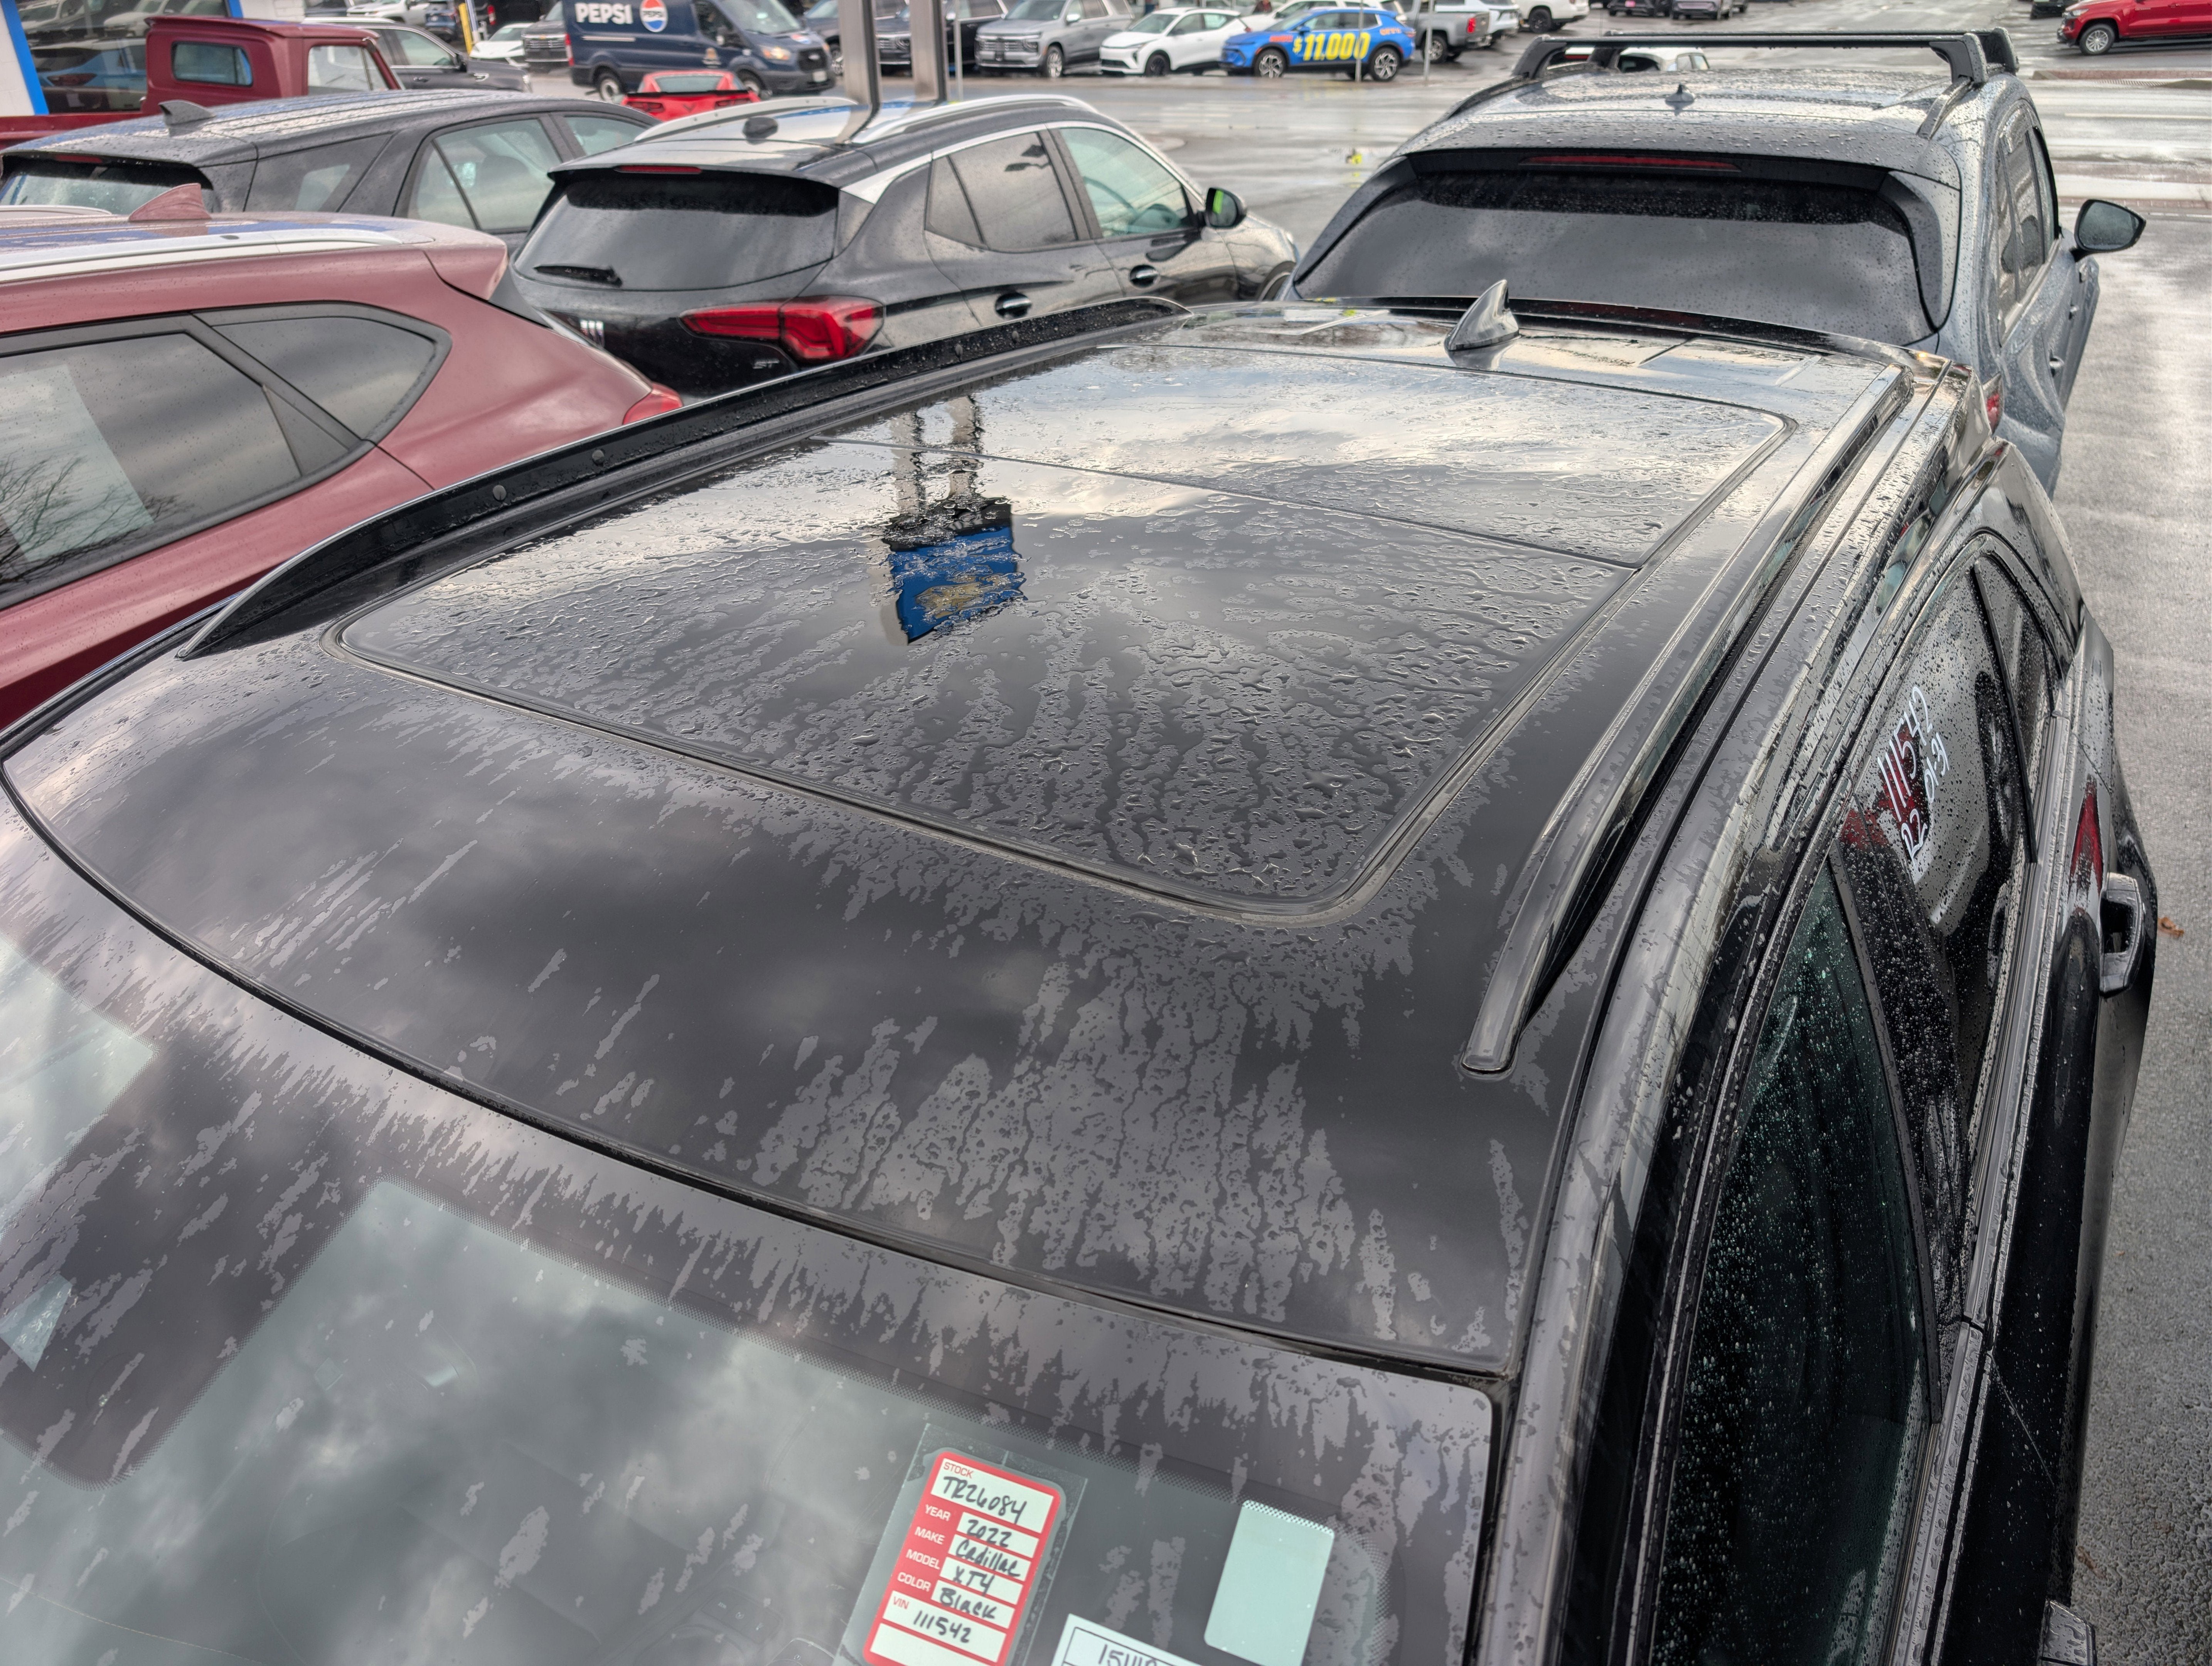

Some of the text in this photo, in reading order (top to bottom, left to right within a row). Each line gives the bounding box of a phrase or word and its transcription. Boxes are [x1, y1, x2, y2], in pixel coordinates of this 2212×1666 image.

[574, 2, 633, 24] PEPSI
[1878, 686, 1932, 822] 111542
[943, 1462, 974, 1479] STOCK
[943, 1476, 1027, 1524] TR26084
[925, 1504, 1012, 1547] YEAR 2022
[914, 1526, 1021, 1577] MAKE Cadillac
[897, 1572, 932, 1592] COLOR
[905, 1549, 995, 1597] MODEL XT4
[893, 1596, 909, 1610] VIN
[913, 1610, 971, 1643] 111542
